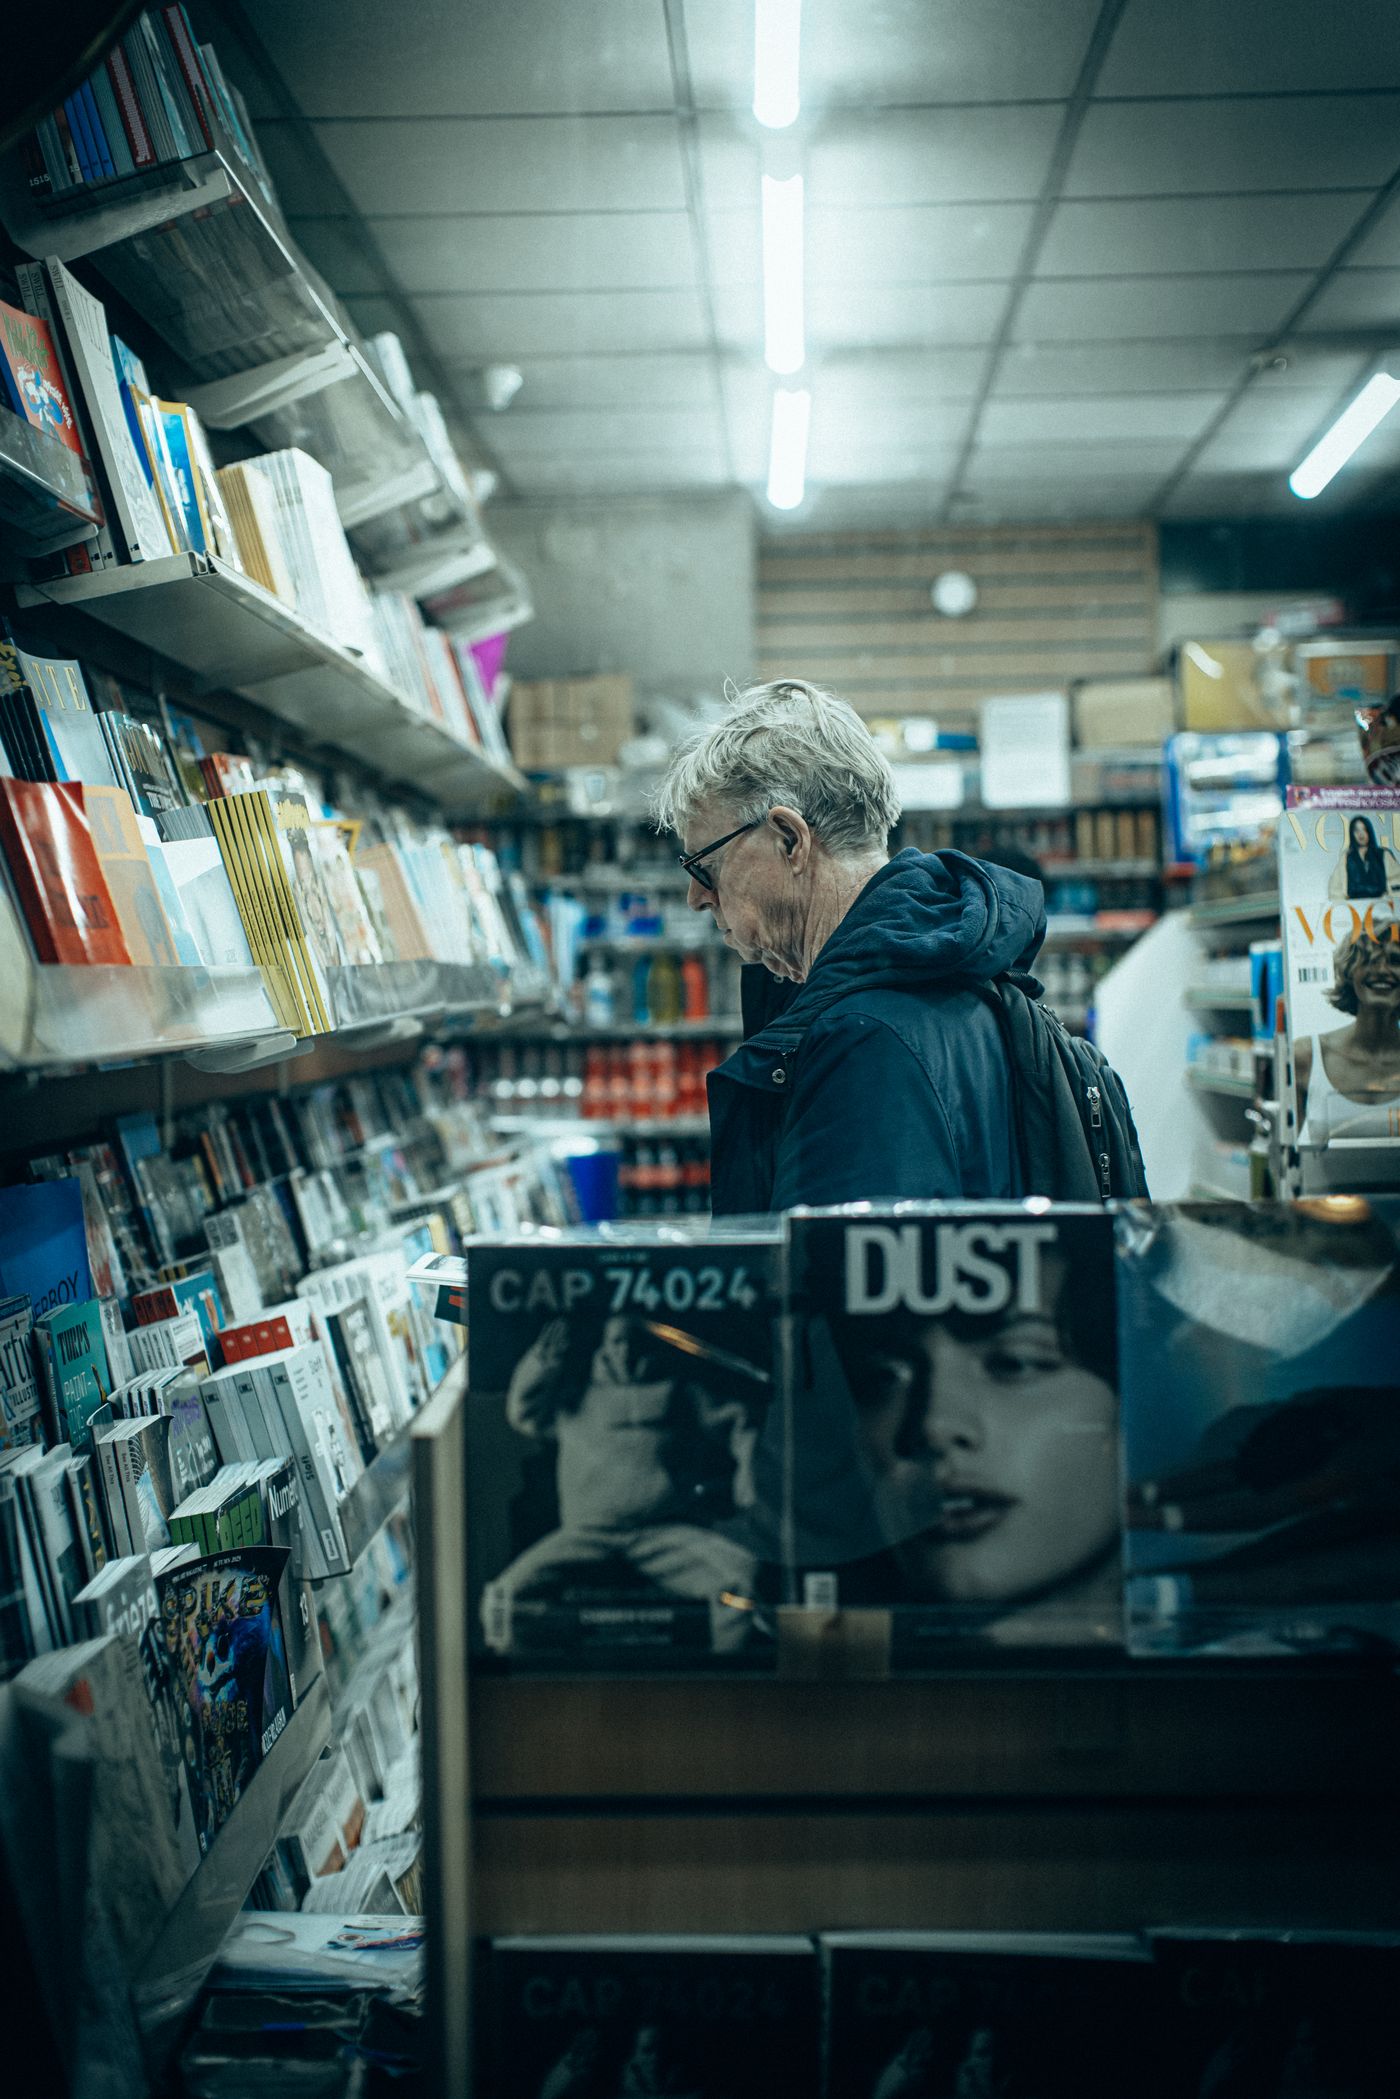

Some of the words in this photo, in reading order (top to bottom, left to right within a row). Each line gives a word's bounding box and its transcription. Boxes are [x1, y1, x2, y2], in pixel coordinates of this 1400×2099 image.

[19, 273, 31, 298] SWILL
[31, 272, 45, 299] SWILL
[50, 264, 64, 290] SWILL
[844, 1224, 1058, 1316] DUST
[490, 1268, 592, 1312] CAP
[606, 1265, 758, 1312] 74024
[57, 1321, 91, 1366] TURPS
